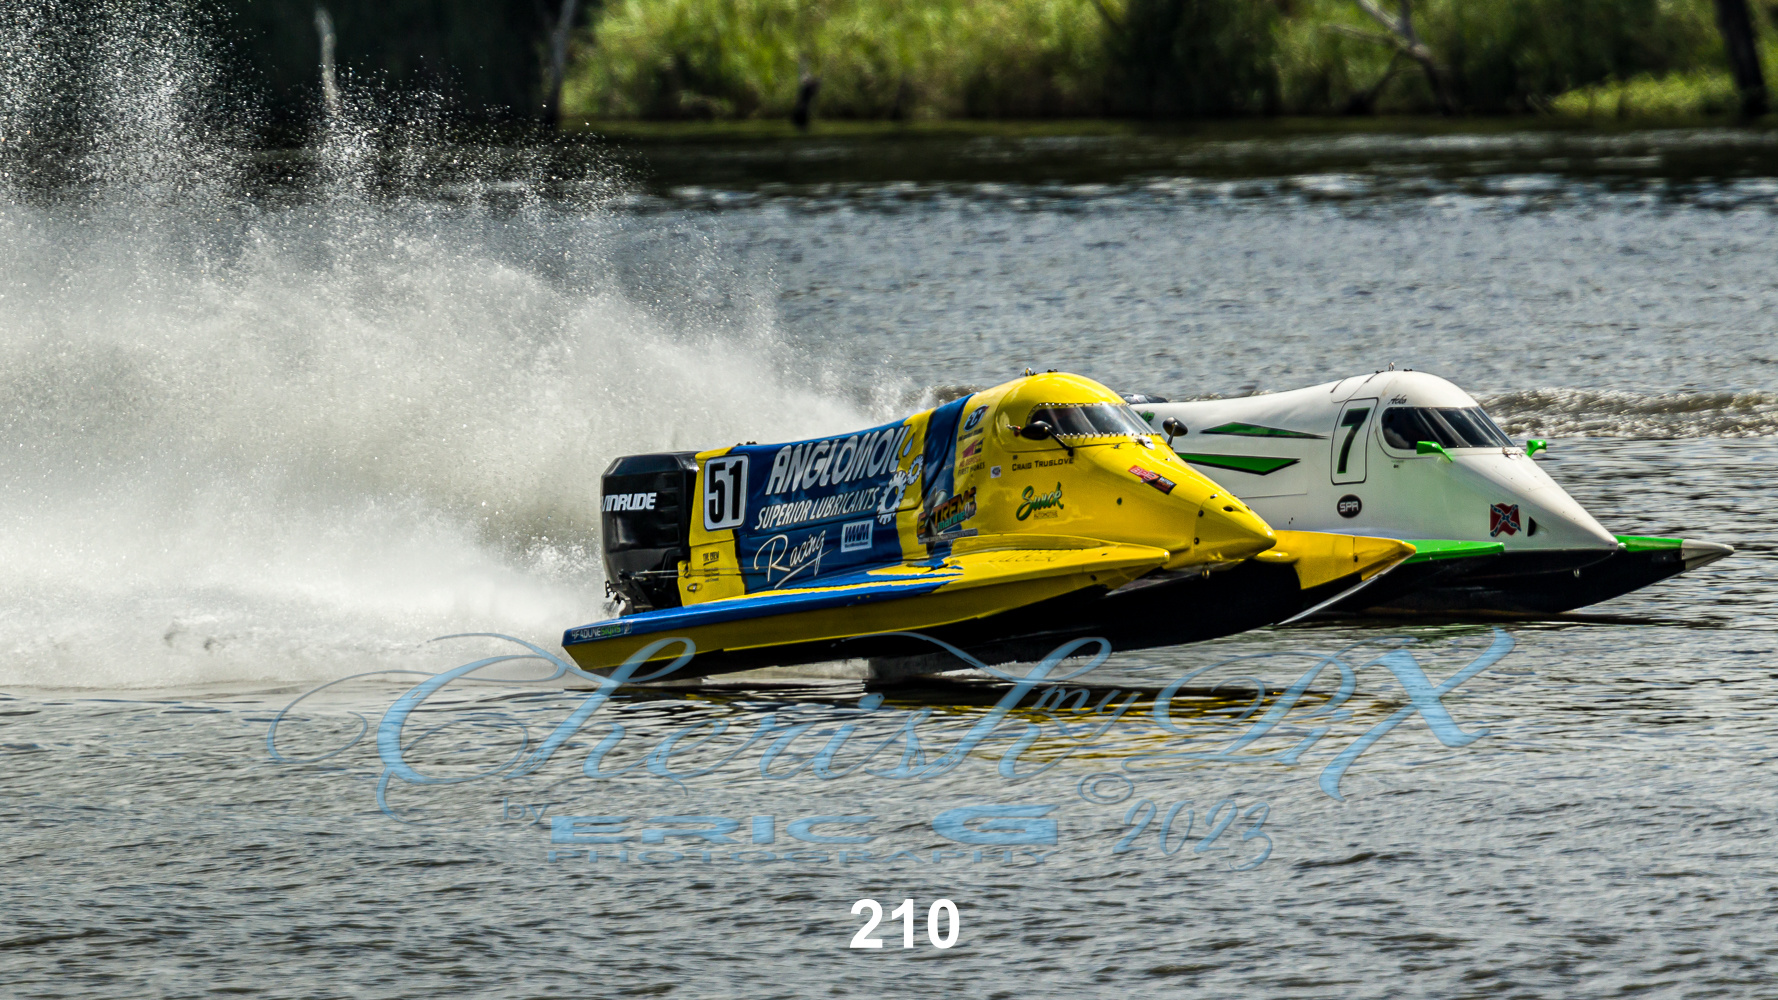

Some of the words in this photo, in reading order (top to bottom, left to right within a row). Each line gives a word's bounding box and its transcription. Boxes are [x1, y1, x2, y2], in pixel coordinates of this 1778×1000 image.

[765, 425, 912, 496] ANGLOMOIL
[1337, 407, 1370, 474] 7
[709, 460, 743, 524] 51
[754, 499, 813, 530] SUPERIOR
[809, 487, 880, 520] LUBRICANTS
[1339, 501, 1359, 512] SPA
[754, 530, 827, 583] Racing
